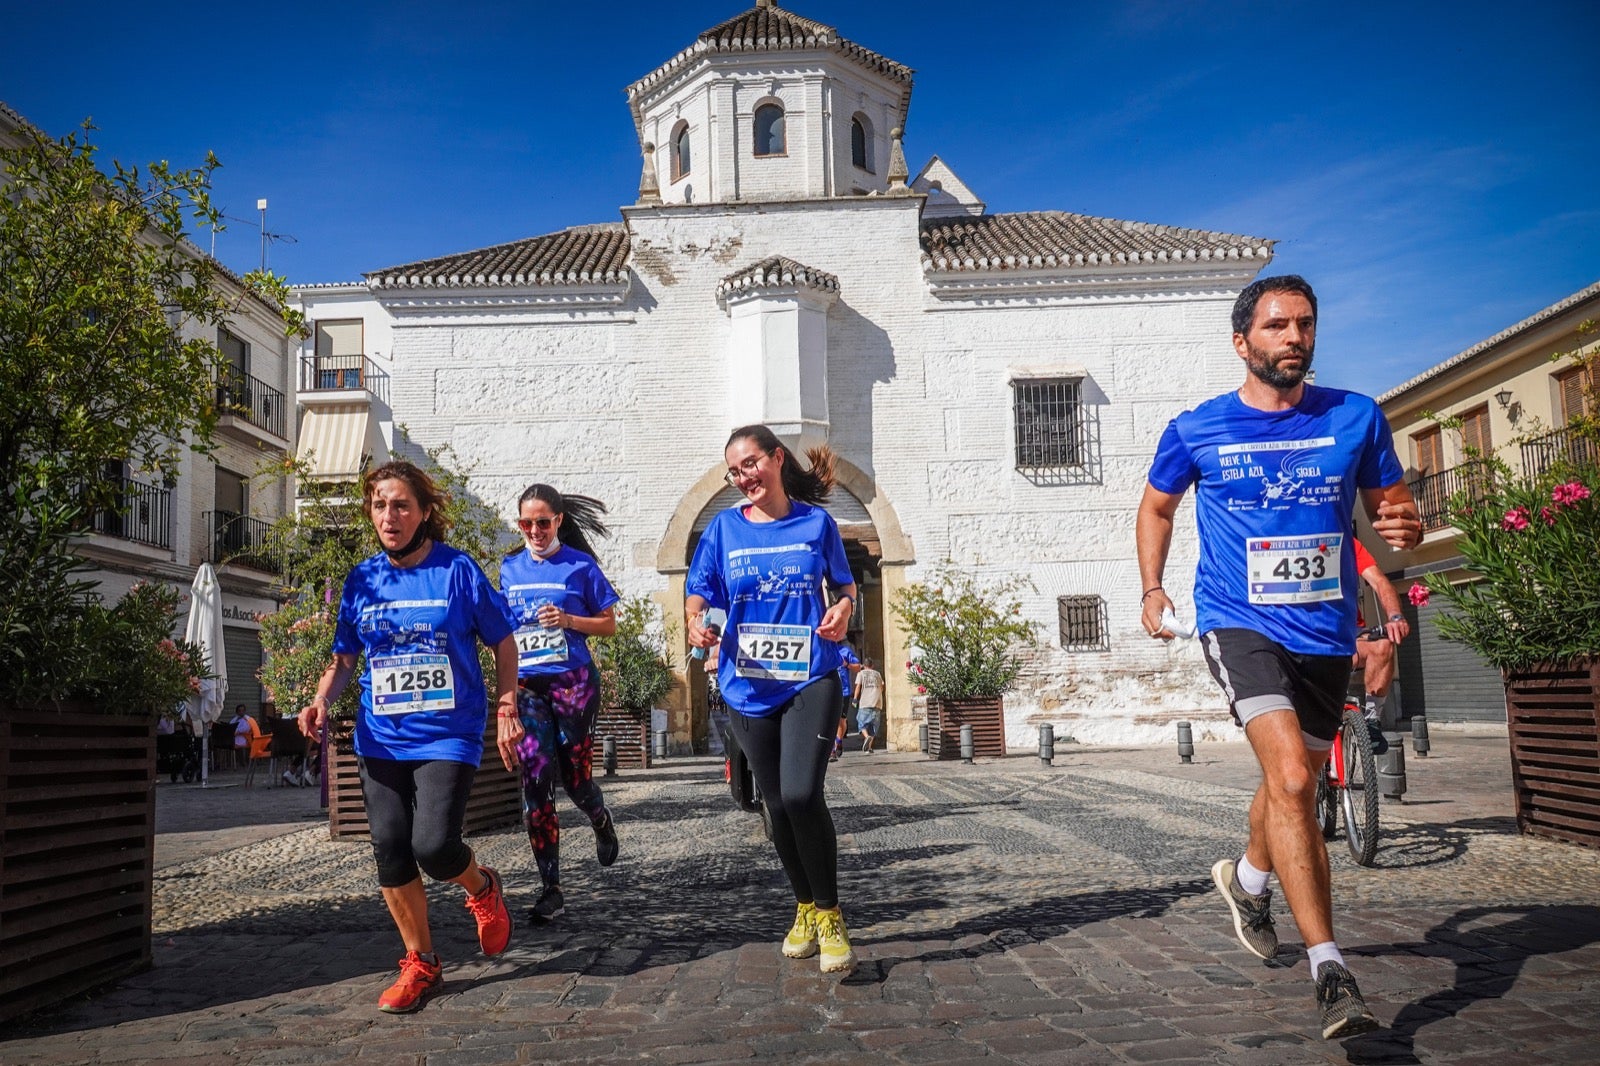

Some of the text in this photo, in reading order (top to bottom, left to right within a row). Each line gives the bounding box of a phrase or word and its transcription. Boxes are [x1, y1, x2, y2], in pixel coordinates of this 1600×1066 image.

[1219, 454, 1252, 467] VUELVE LA
[1222, 467, 1245, 481] ESTELA
[1248, 466, 1265, 478] AZUL
[1287, 540, 1300, 549] AZUL
[1273, 555, 1326, 580] 433
[749, 640, 805, 660] 1257
[385, 669, 447, 692] 1258
